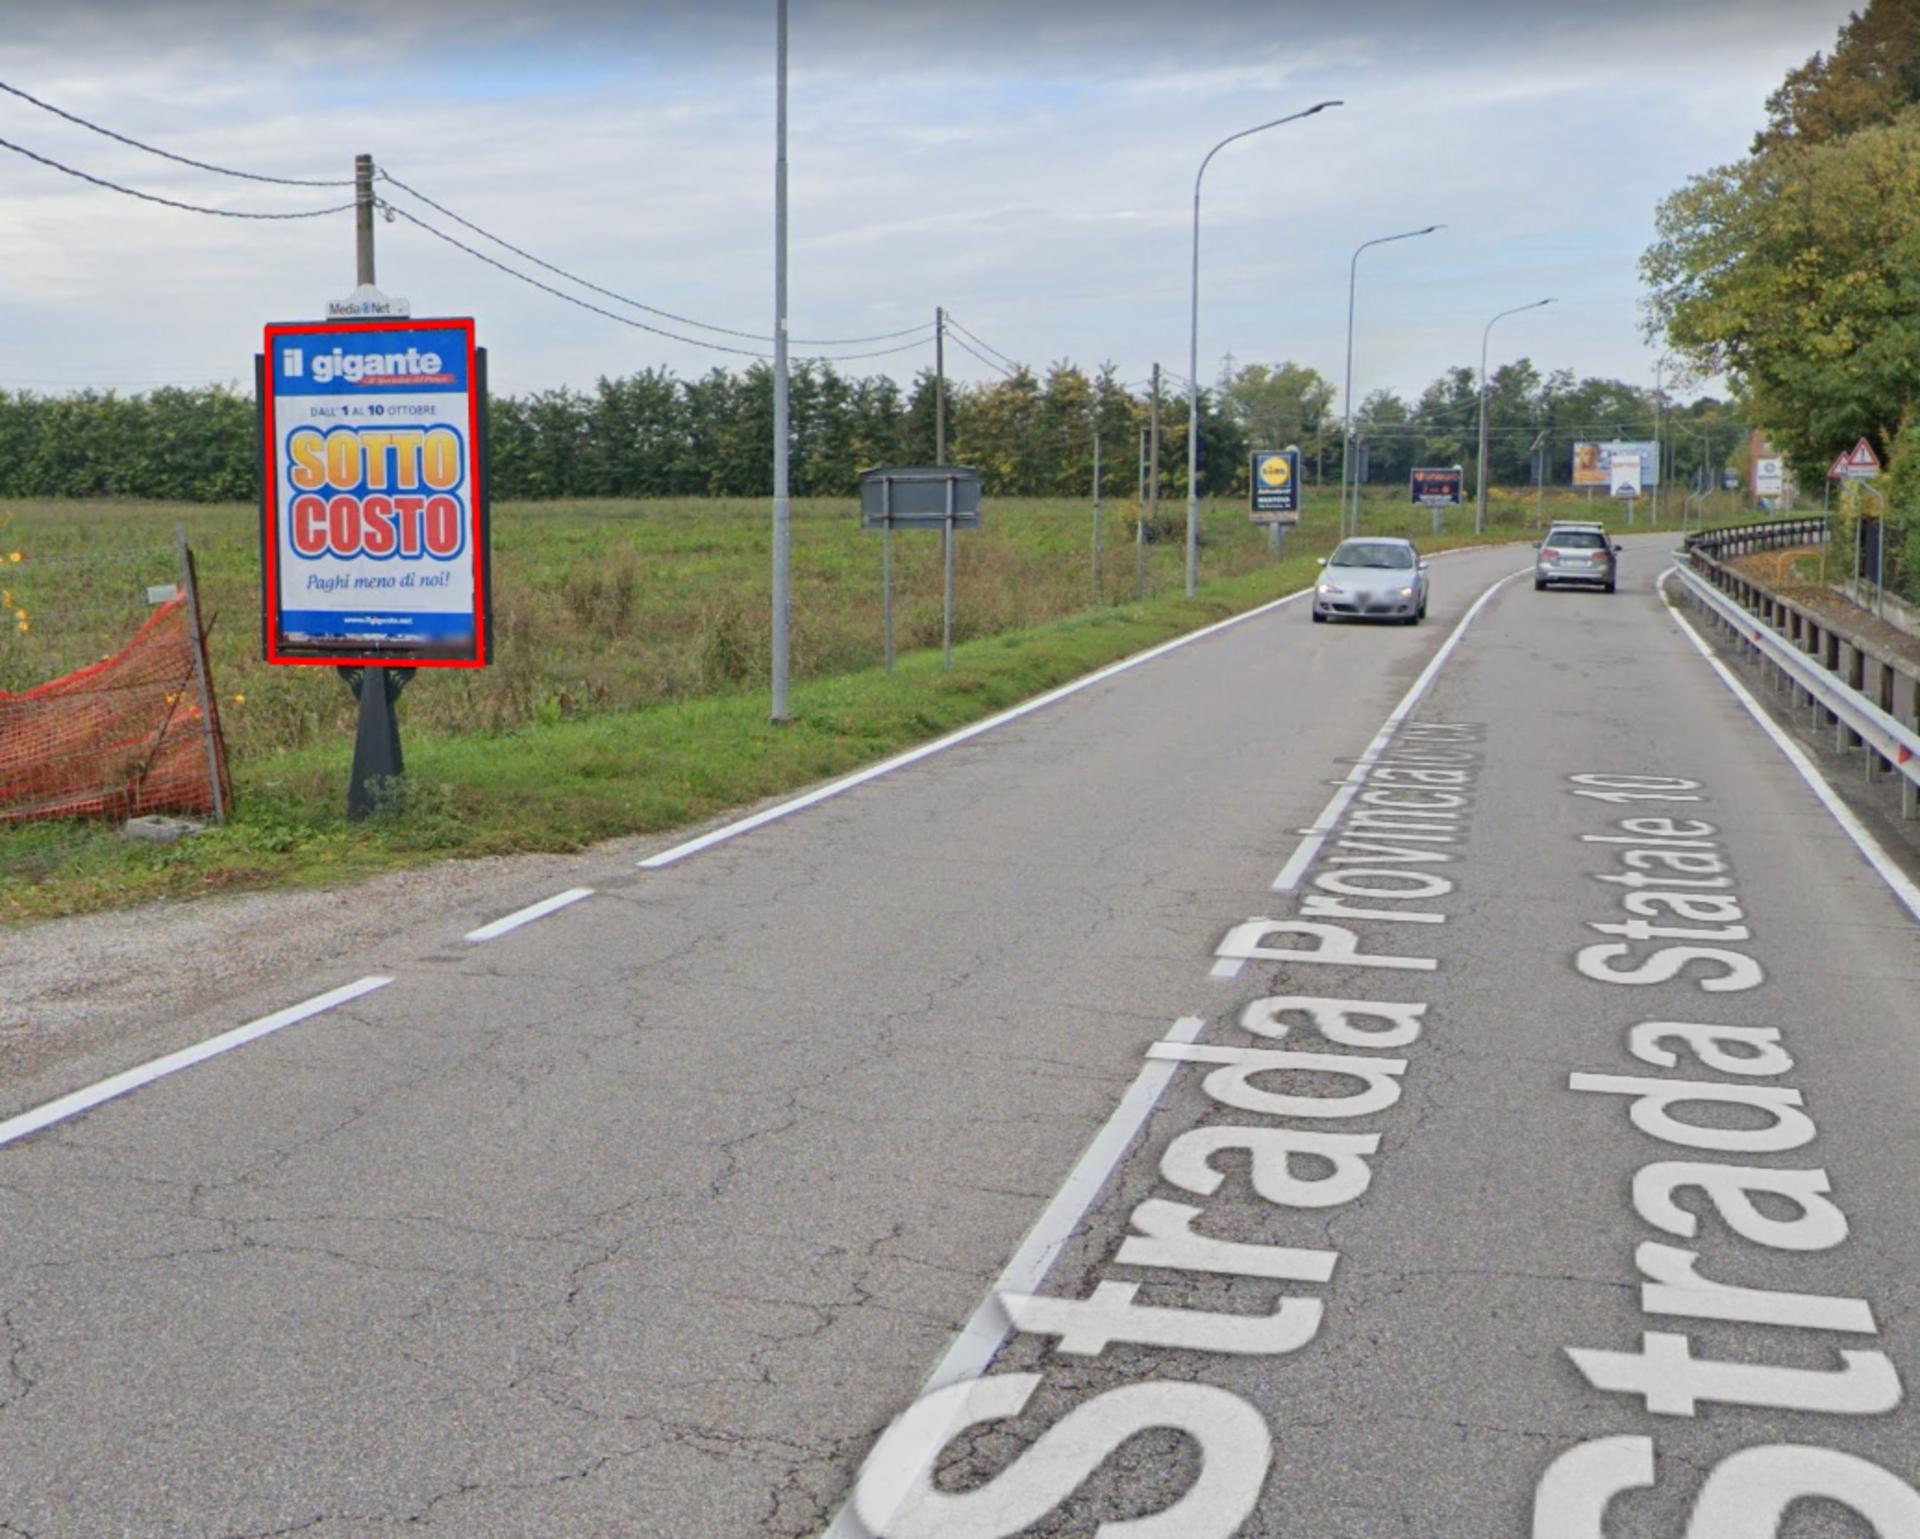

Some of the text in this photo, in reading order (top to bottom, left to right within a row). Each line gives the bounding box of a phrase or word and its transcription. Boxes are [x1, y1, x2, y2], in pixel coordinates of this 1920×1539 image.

[283, 347, 442, 382] il gigante
[342, 405, 349, 416] 1
[352, 405, 364, 416] AL
[368, 405, 384, 416] 10
[387, 404, 436, 416] OTTOBRE
[291, 429, 459, 489] SOTTO
[294, 495, 459, 555] COSTO
[307, 571, 450, 592] Paghi meno di noi!
